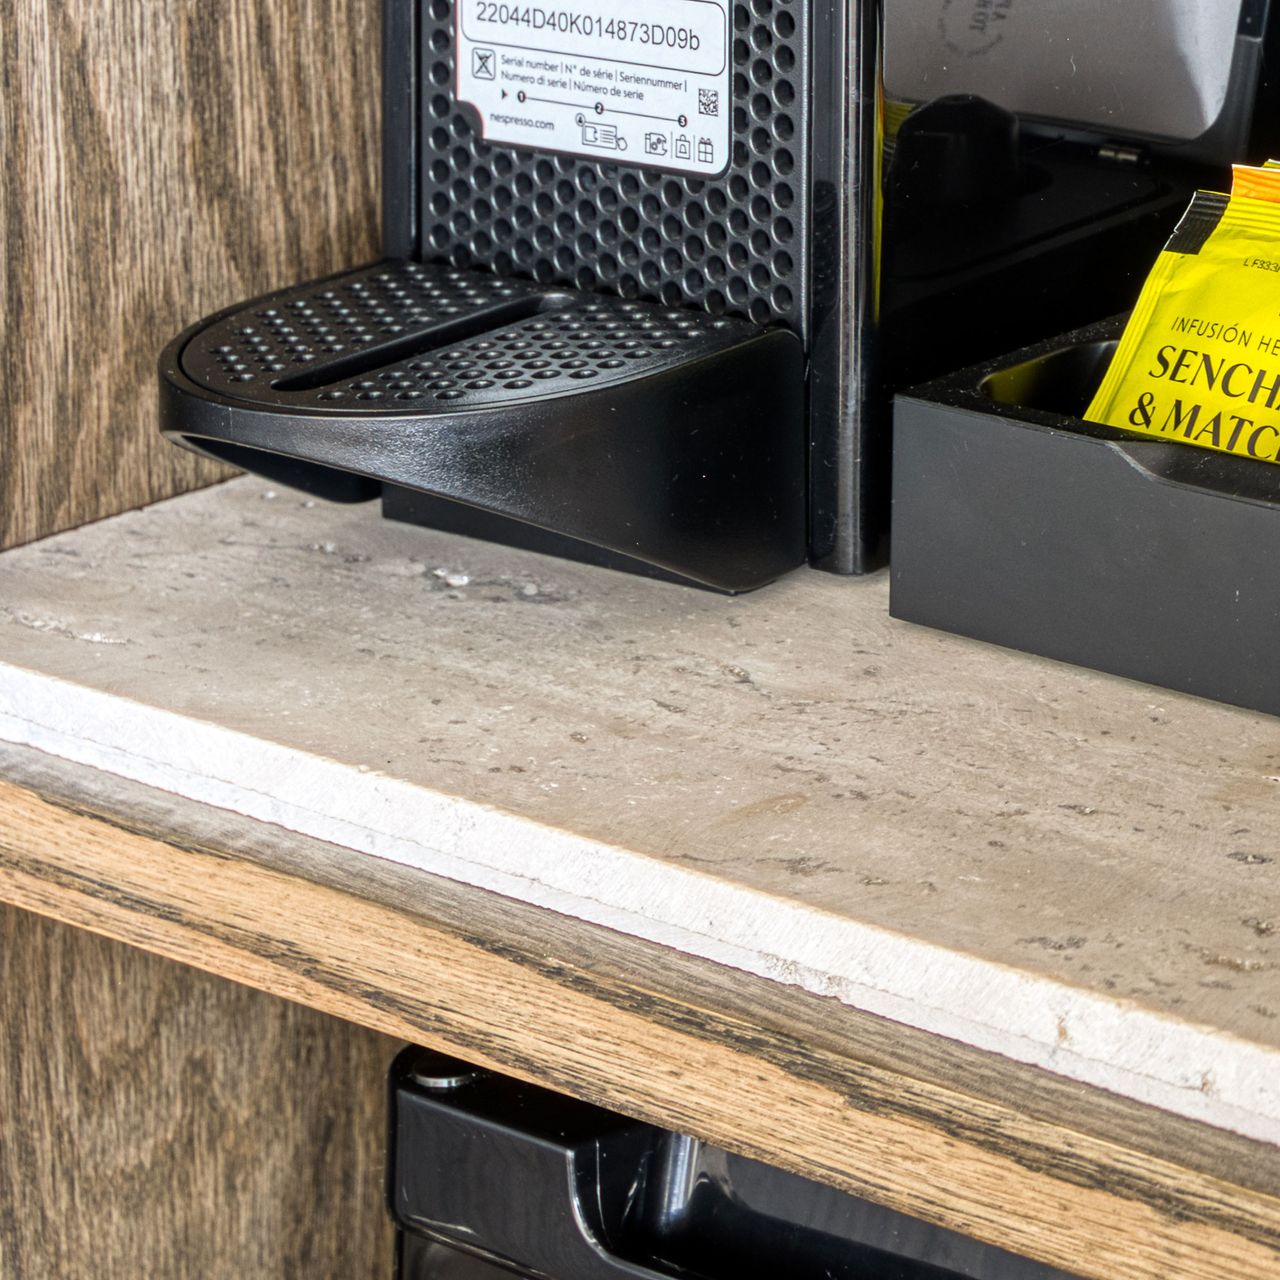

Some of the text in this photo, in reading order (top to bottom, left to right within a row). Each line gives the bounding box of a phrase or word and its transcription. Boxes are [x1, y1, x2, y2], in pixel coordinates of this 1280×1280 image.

[476, 1, 700, 51] 22044D40K014873D09b
[501, 54, 524, 67] Serial
[526, 60, 559, 72] number
[580, 66, 591, 76] de
[593, 68, 613, 80] série
[620, 72, 682, 90] Seriennummer
[501, 71, 644, 100] Numero di serie Número de serie
[490, 113, 555, 130] nespresso.com
[1171, 315, 1251, 347] INFUSIÓN
[1128, 392, 1156, 429] &
